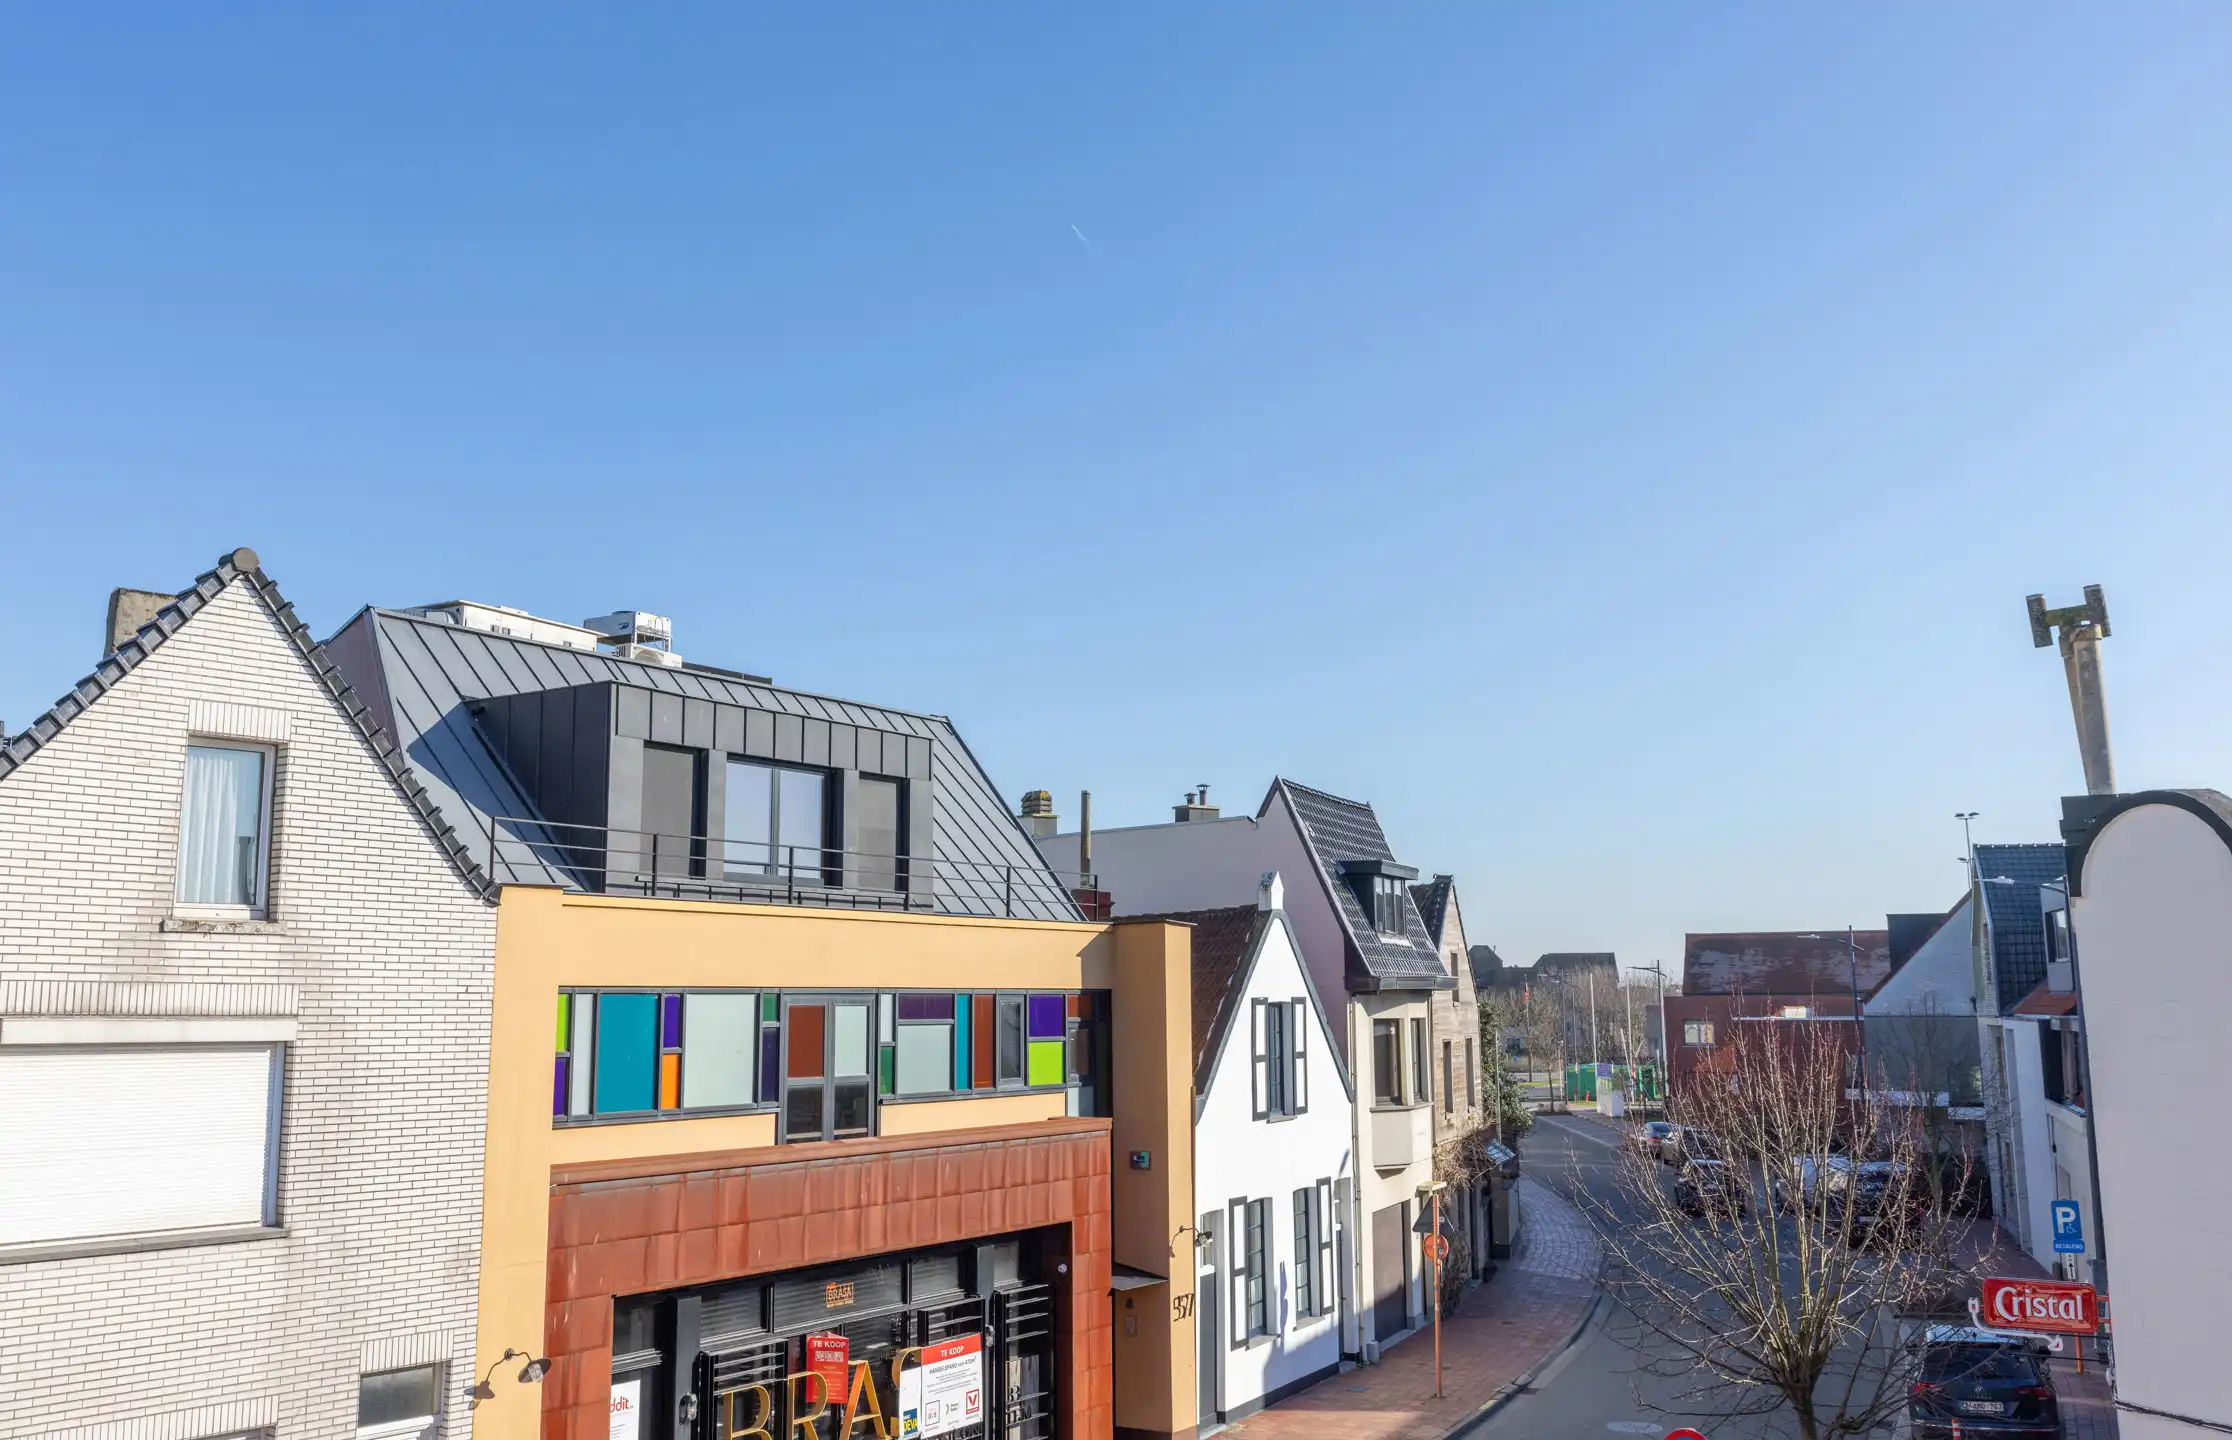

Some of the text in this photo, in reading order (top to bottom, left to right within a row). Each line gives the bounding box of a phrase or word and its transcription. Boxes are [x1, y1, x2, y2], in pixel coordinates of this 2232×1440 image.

[2056, 1207, 2076, 1233] P
[1995, 1286, 2083, 1321] Cristal
[812, 1340, 846, 1348] TE KOOP
[941, 1345, 964, 1358] TE KOOP
